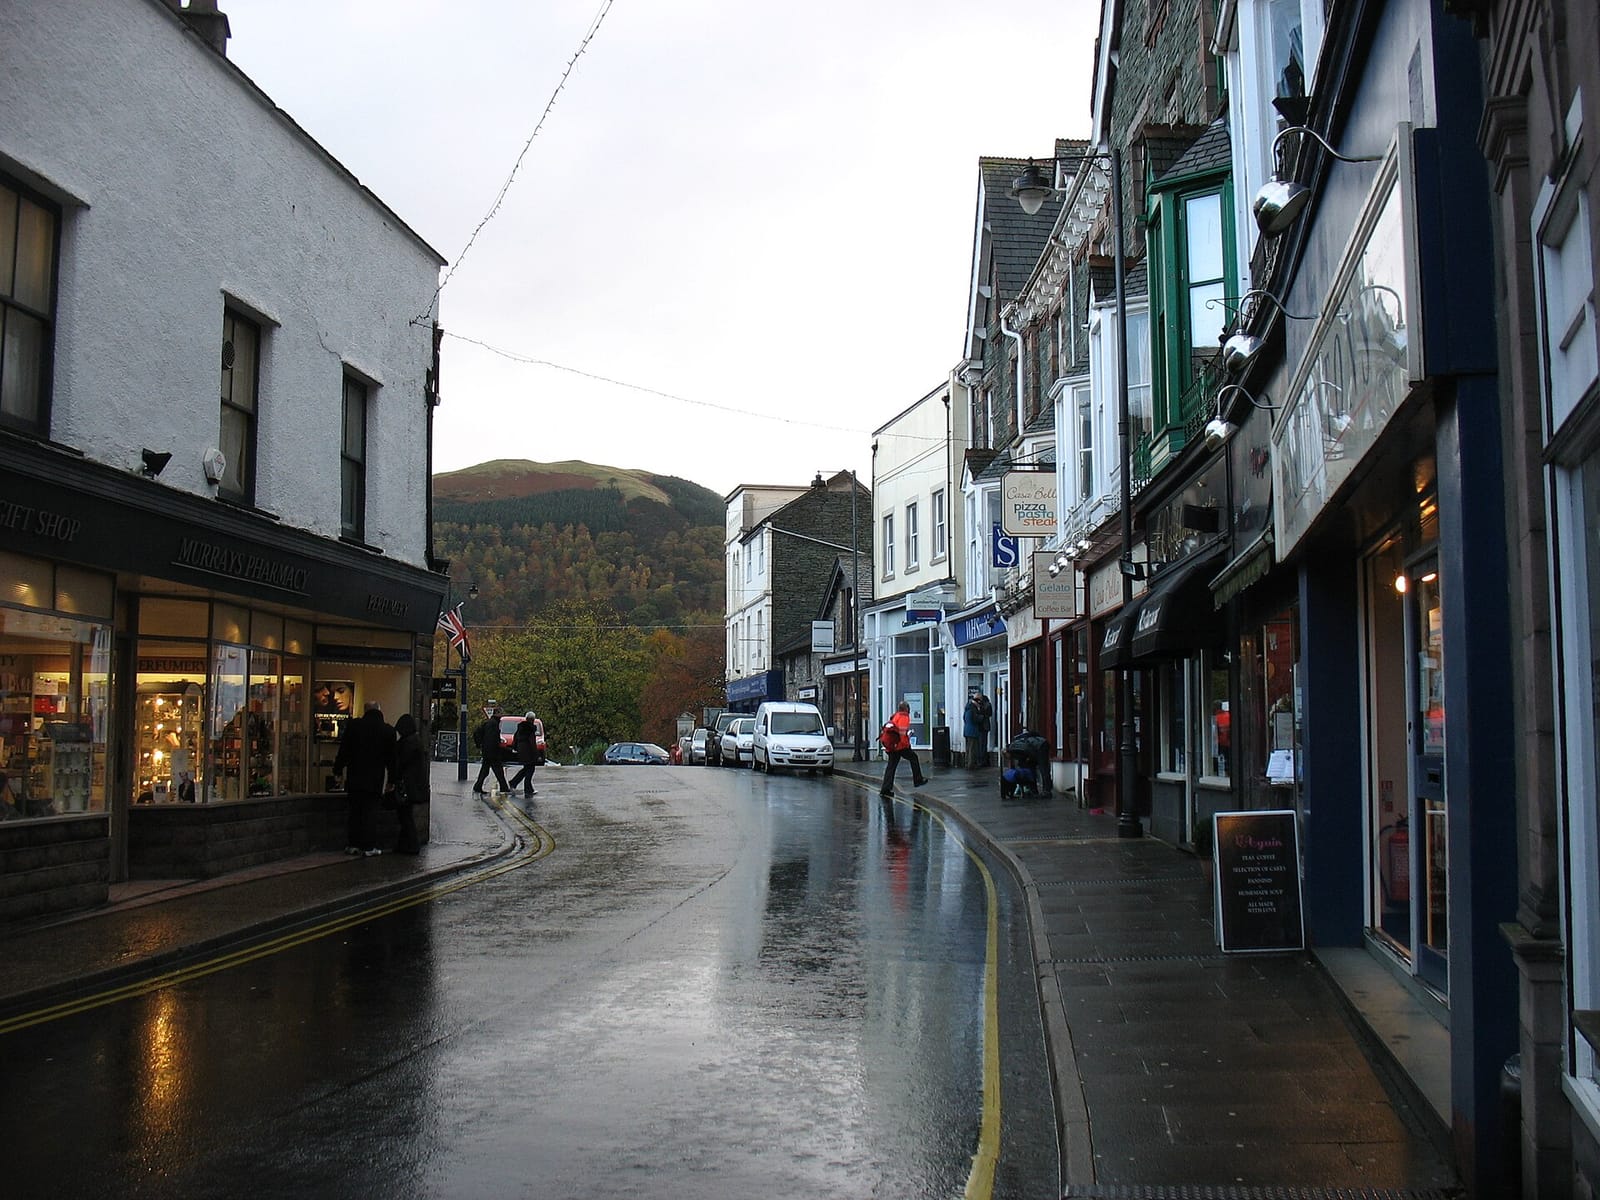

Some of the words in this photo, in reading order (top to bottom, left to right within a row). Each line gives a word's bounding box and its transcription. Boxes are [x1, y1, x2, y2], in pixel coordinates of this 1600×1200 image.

[1007, 486, 1033, 500] Casa
[1034, 486, 1057, 500] Bell
[1014, 501, 1047, 514] pizza
[1017, 511, 1055, 521] pasta
[1023, 518, 1058, 527] steak
[36, 511, 81, 542] SHOP
[245, 554, 312, 591] PHARMACY
[1038, 583, 1072, 593] Gelato
[1037, 605, 1060, 613] Coffee
[1060, 605, 1073, 613] Bar
[139, 659, 207, 672] ERFUMERY
